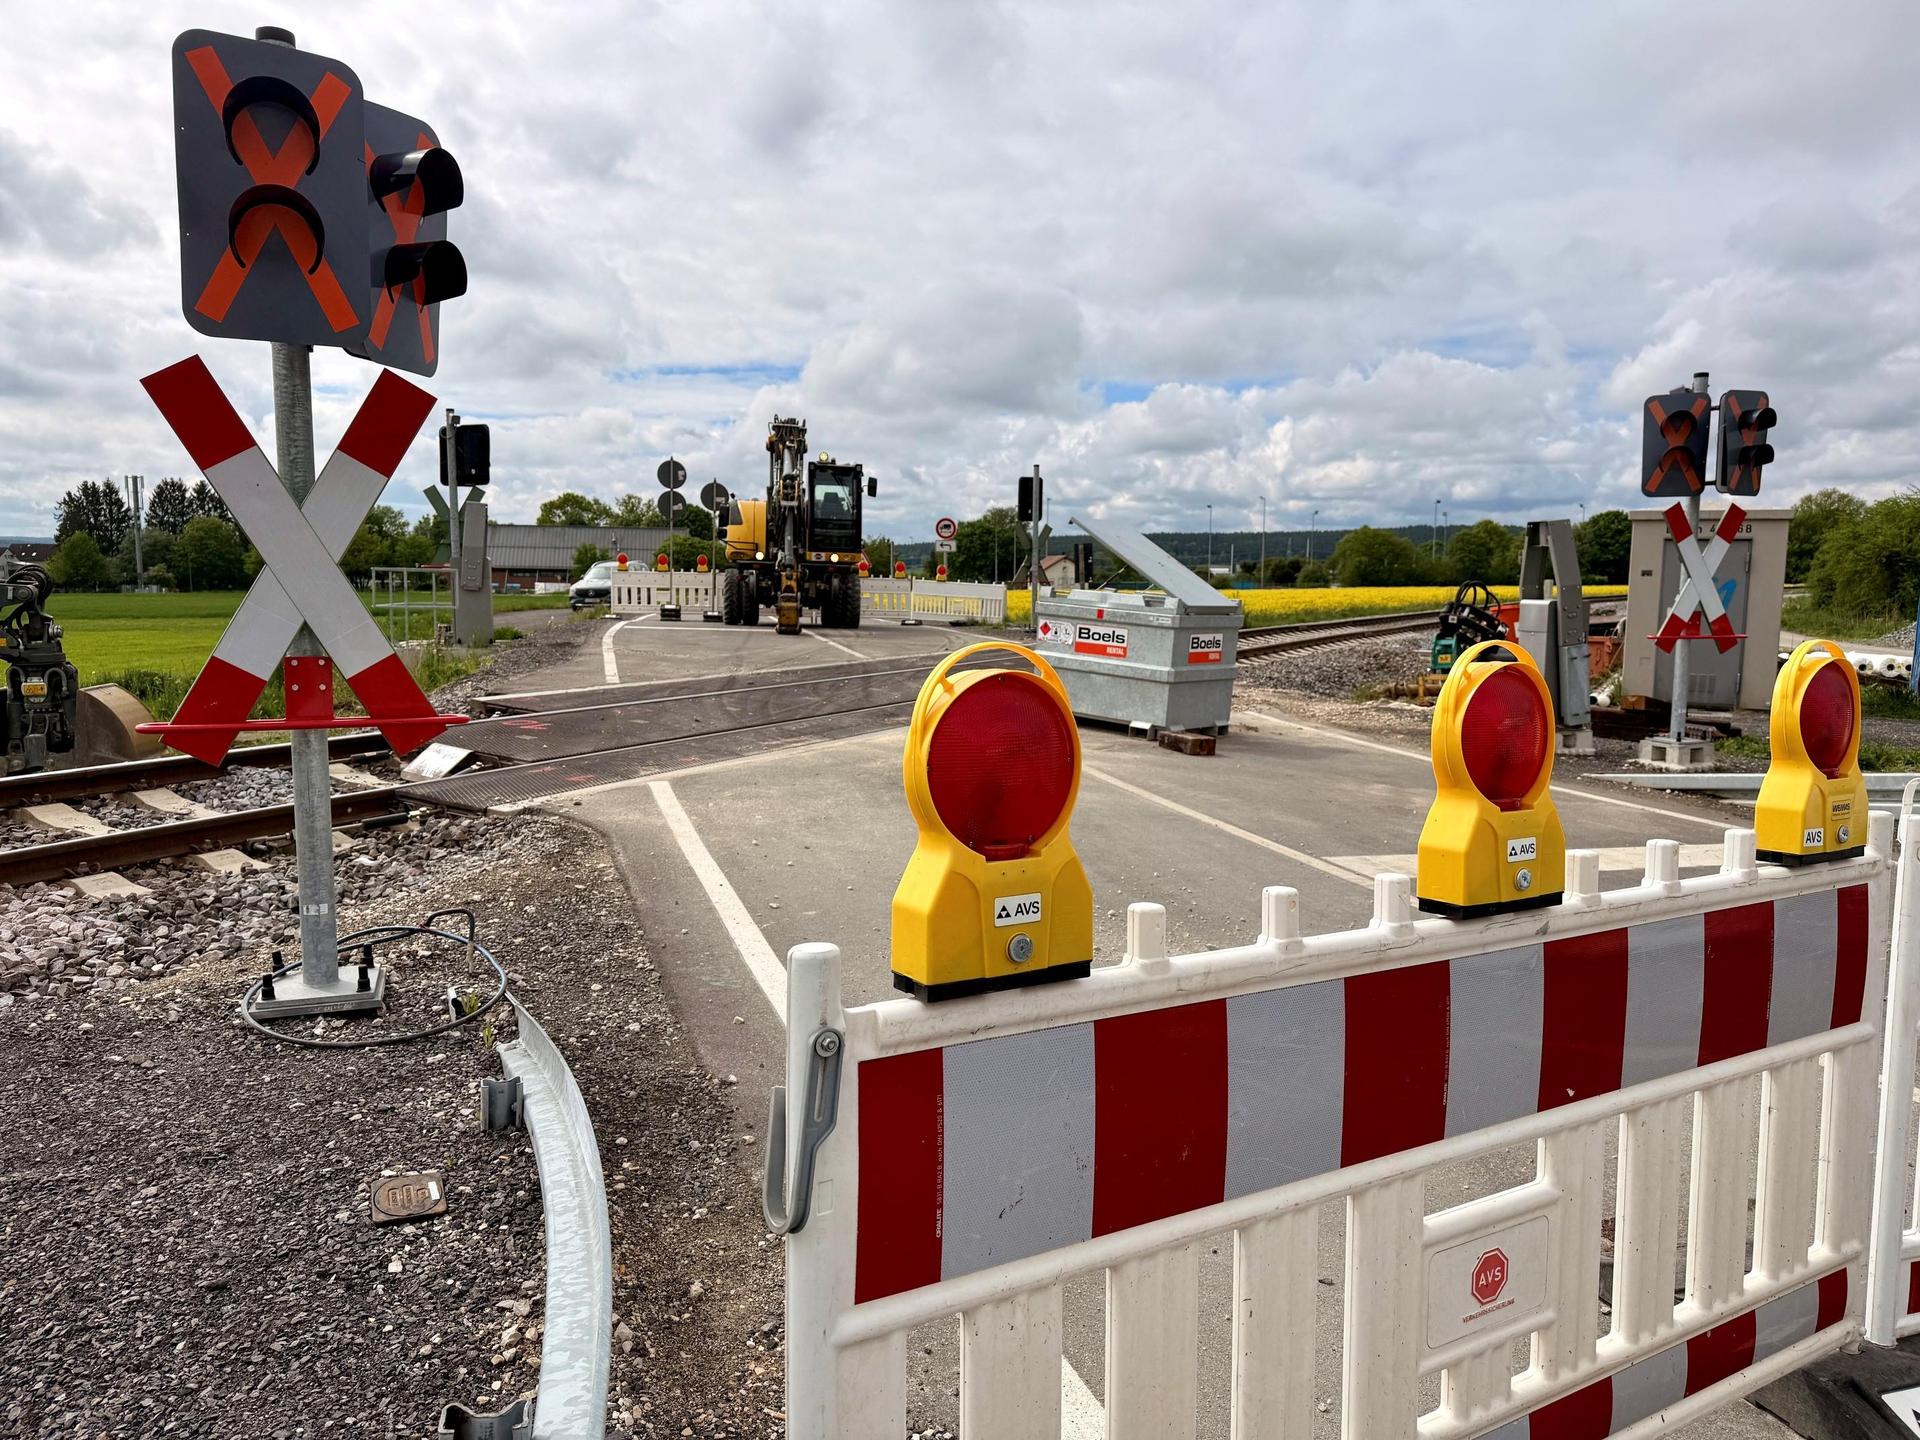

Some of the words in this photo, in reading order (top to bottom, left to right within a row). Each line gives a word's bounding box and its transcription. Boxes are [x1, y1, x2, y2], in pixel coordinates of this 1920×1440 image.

[1078, 627, 1126, 644] Boels
[1190, 636, 1221, 650] Boels
[1806, 830, 1822, 844] AVS
[1519, 843, 1535, 855] AVS
[1014, 901, 1040, 916] AVS
[1478, 1267, 1502, 1287] AVS
